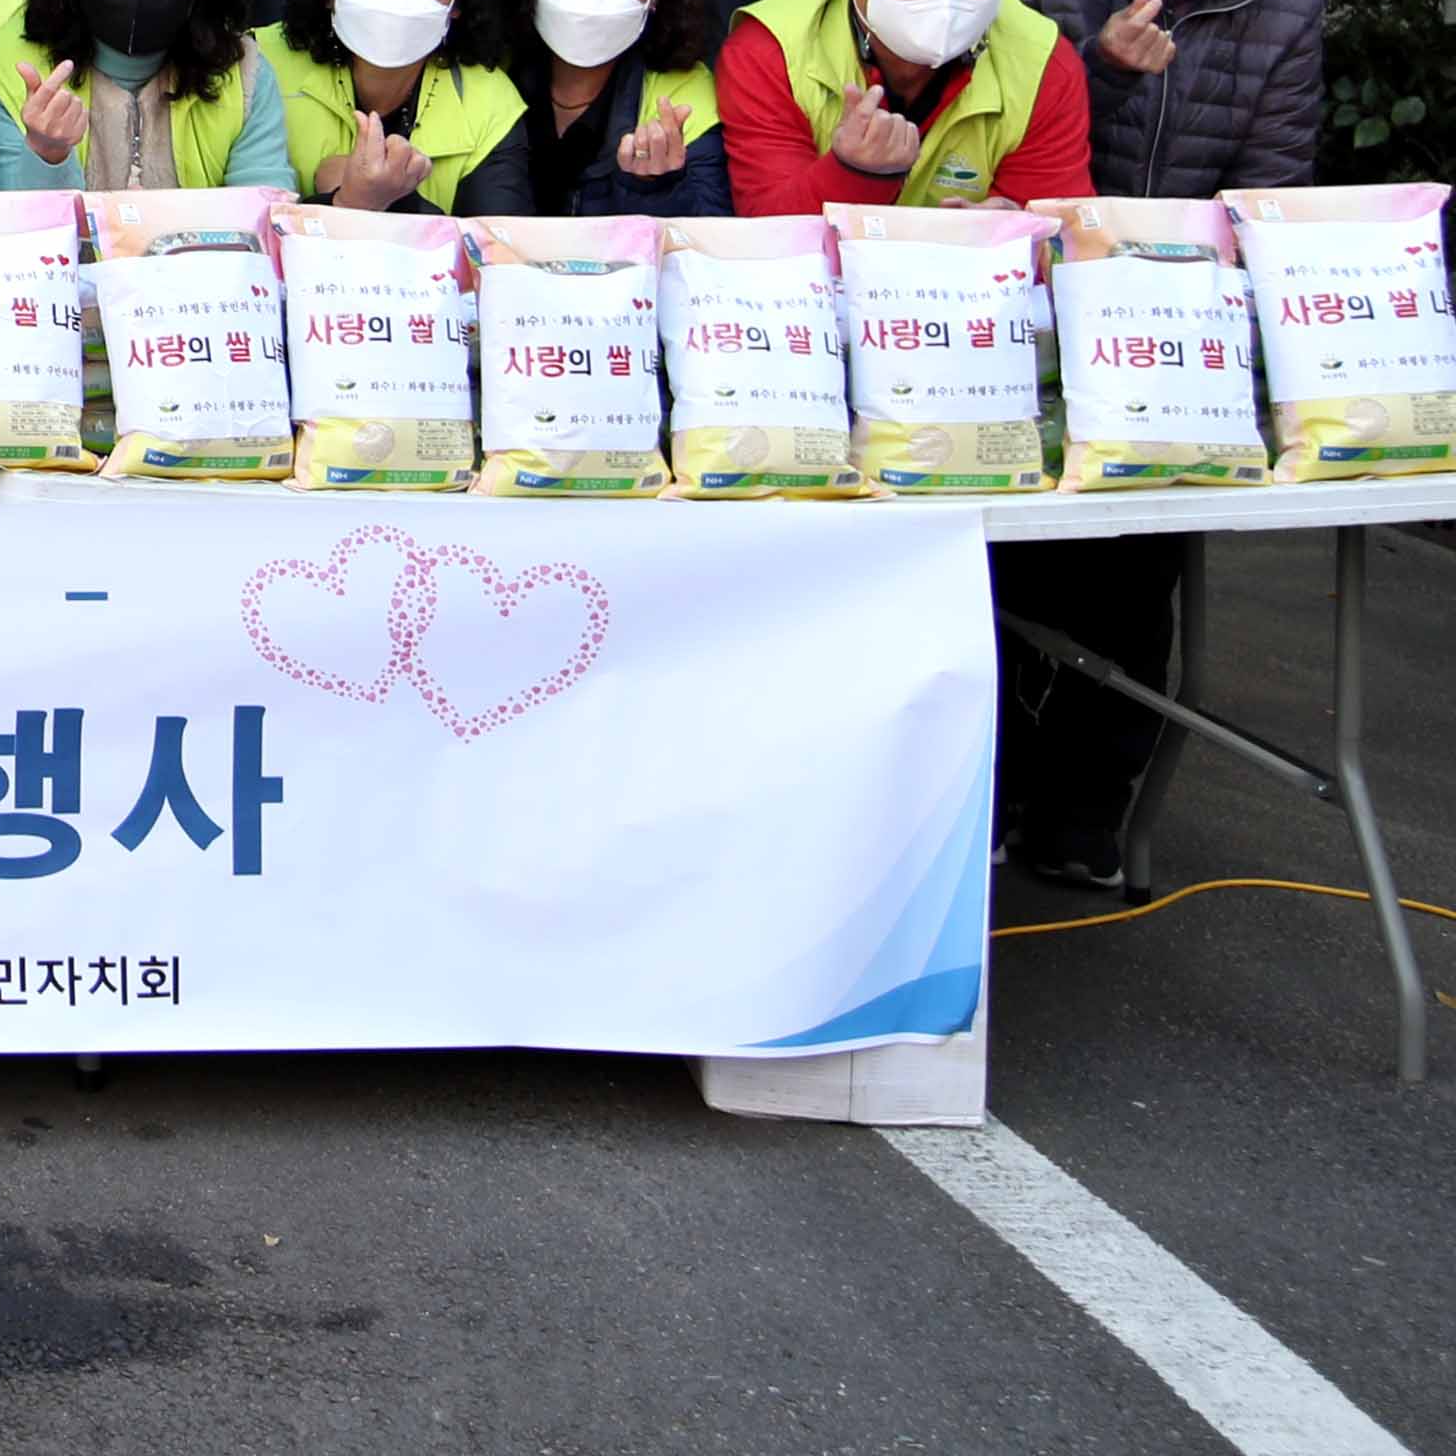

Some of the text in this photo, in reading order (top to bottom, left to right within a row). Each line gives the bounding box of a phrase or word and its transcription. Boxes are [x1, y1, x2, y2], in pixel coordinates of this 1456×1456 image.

[10, 297, 39, 328] 쌀
[1279, 294, 1374, 327] 사랑의
[1388, 289, 1418, 318] 쌀
[305, 313, 392, 345] 사랑의
[407, 313, 435, 344] 쌀
[686, 322, 771, 355] 사랑의
[784, 323, 811, 355] 쌀
[861, 319, 949, 350] 사랑의
[966, 318, 995, 348] 쌀
[128, 334, 212, 369] 사랑의
[225, 331, 252, 363] 쌀
[504, 345, 592, 378] 사랑의
[606, 345, 632, 376] 쌀
[1091, 337, 1183, 368] 사랑의
[1200, 337, 1225, 369] 쌀
[330, 470, 348, 480] NH
